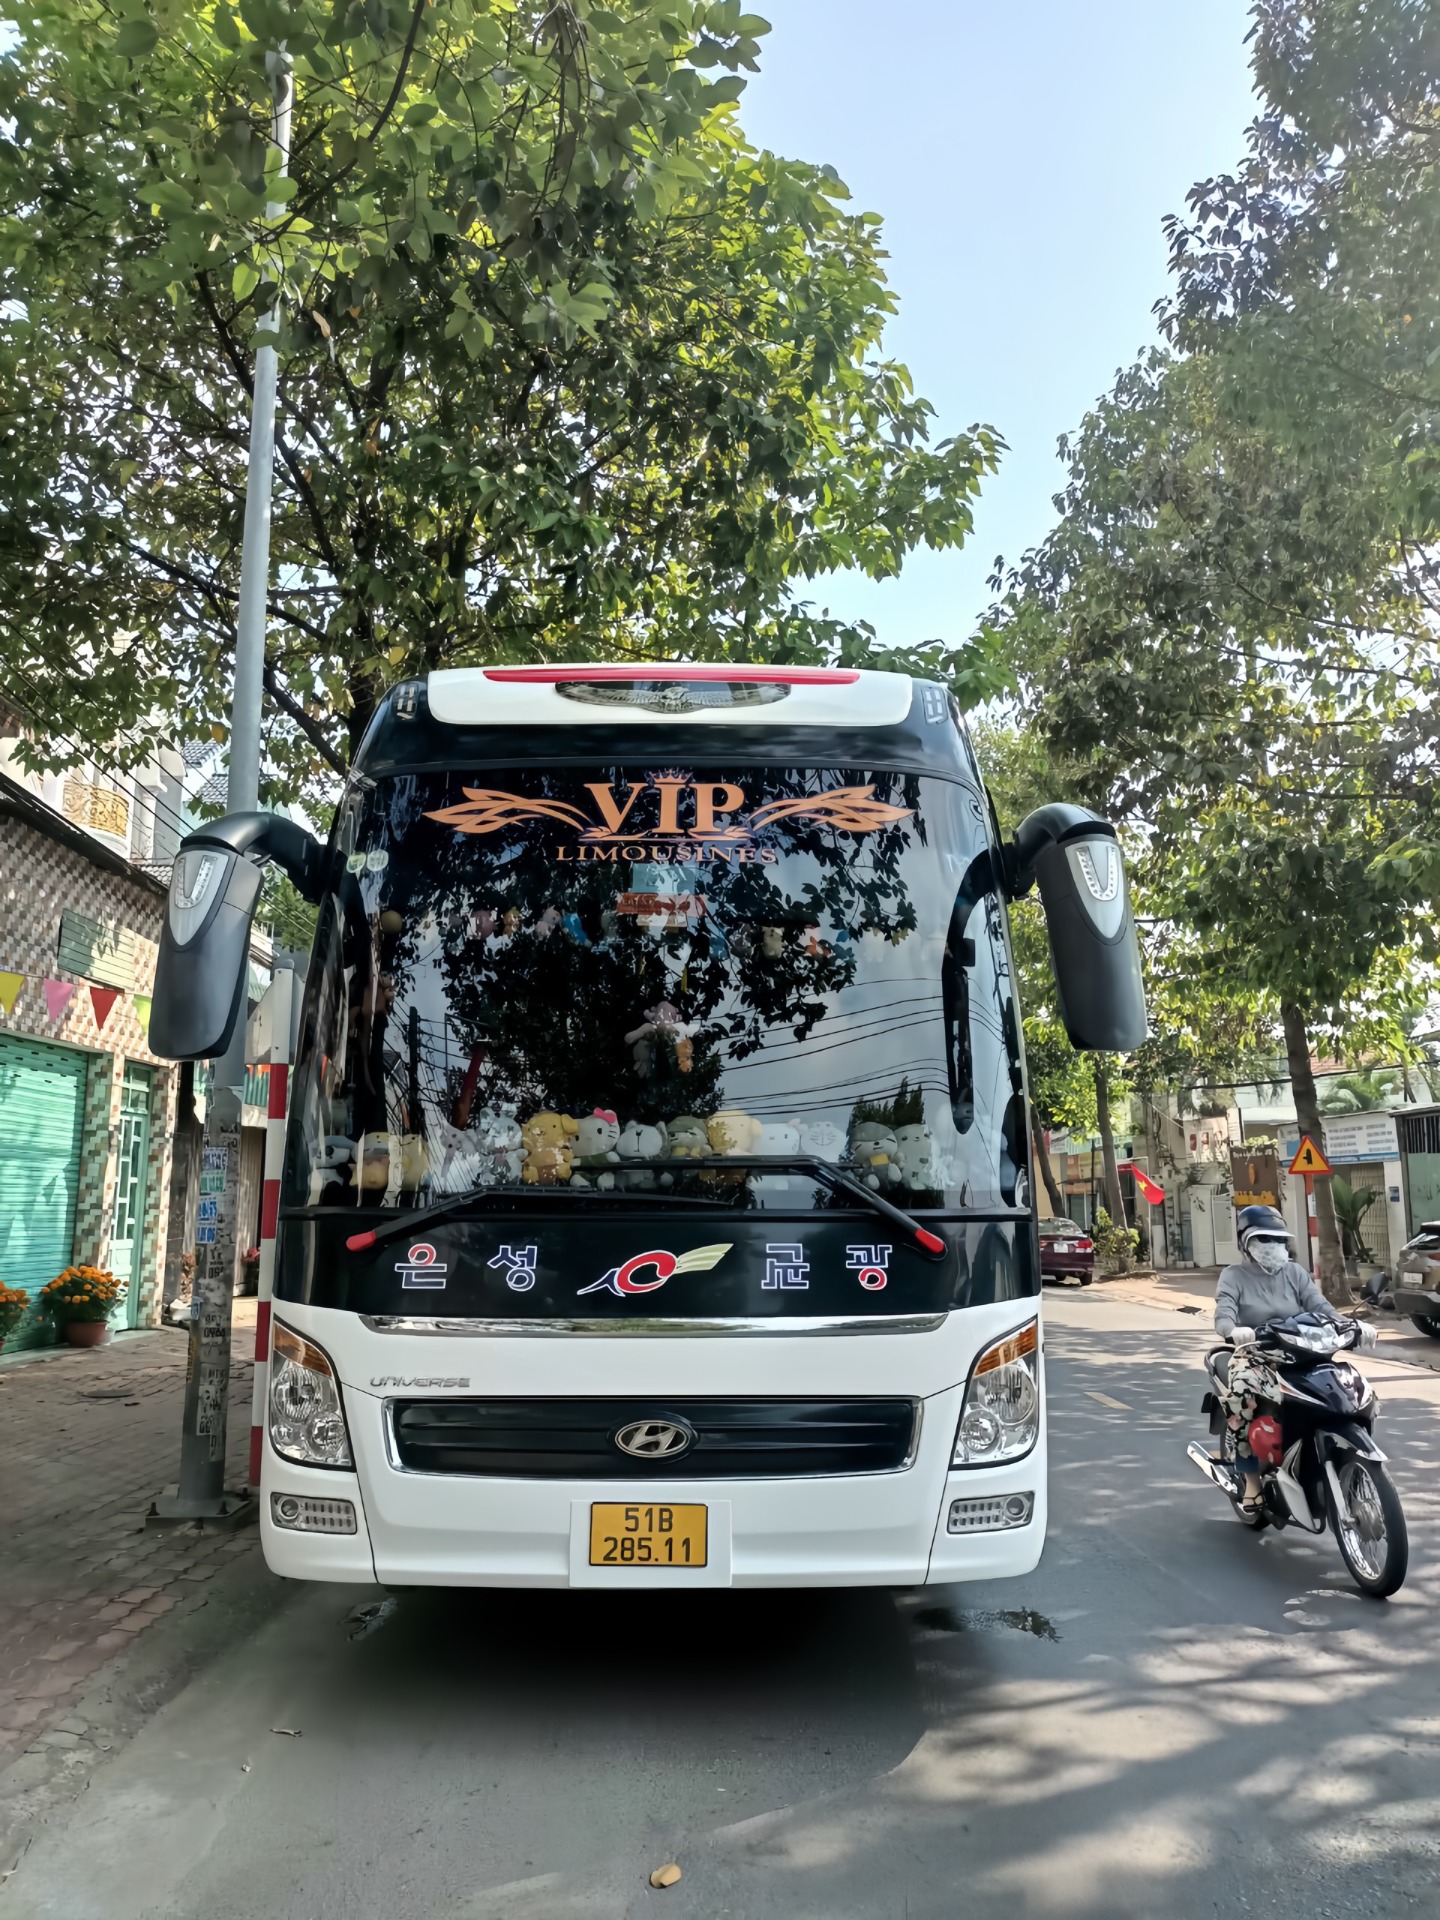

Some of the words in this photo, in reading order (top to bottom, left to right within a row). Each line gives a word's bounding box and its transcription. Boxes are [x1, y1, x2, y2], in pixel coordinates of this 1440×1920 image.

[584, 782, 745, 834] VIP
[555, 844, 779, 865] LIMOUSINES
[369, 1375, 471, 1388] UNIVERSE
[624, 1507, 674, 1533] 51B
[602, 1536, 691, 1562] 285.11
